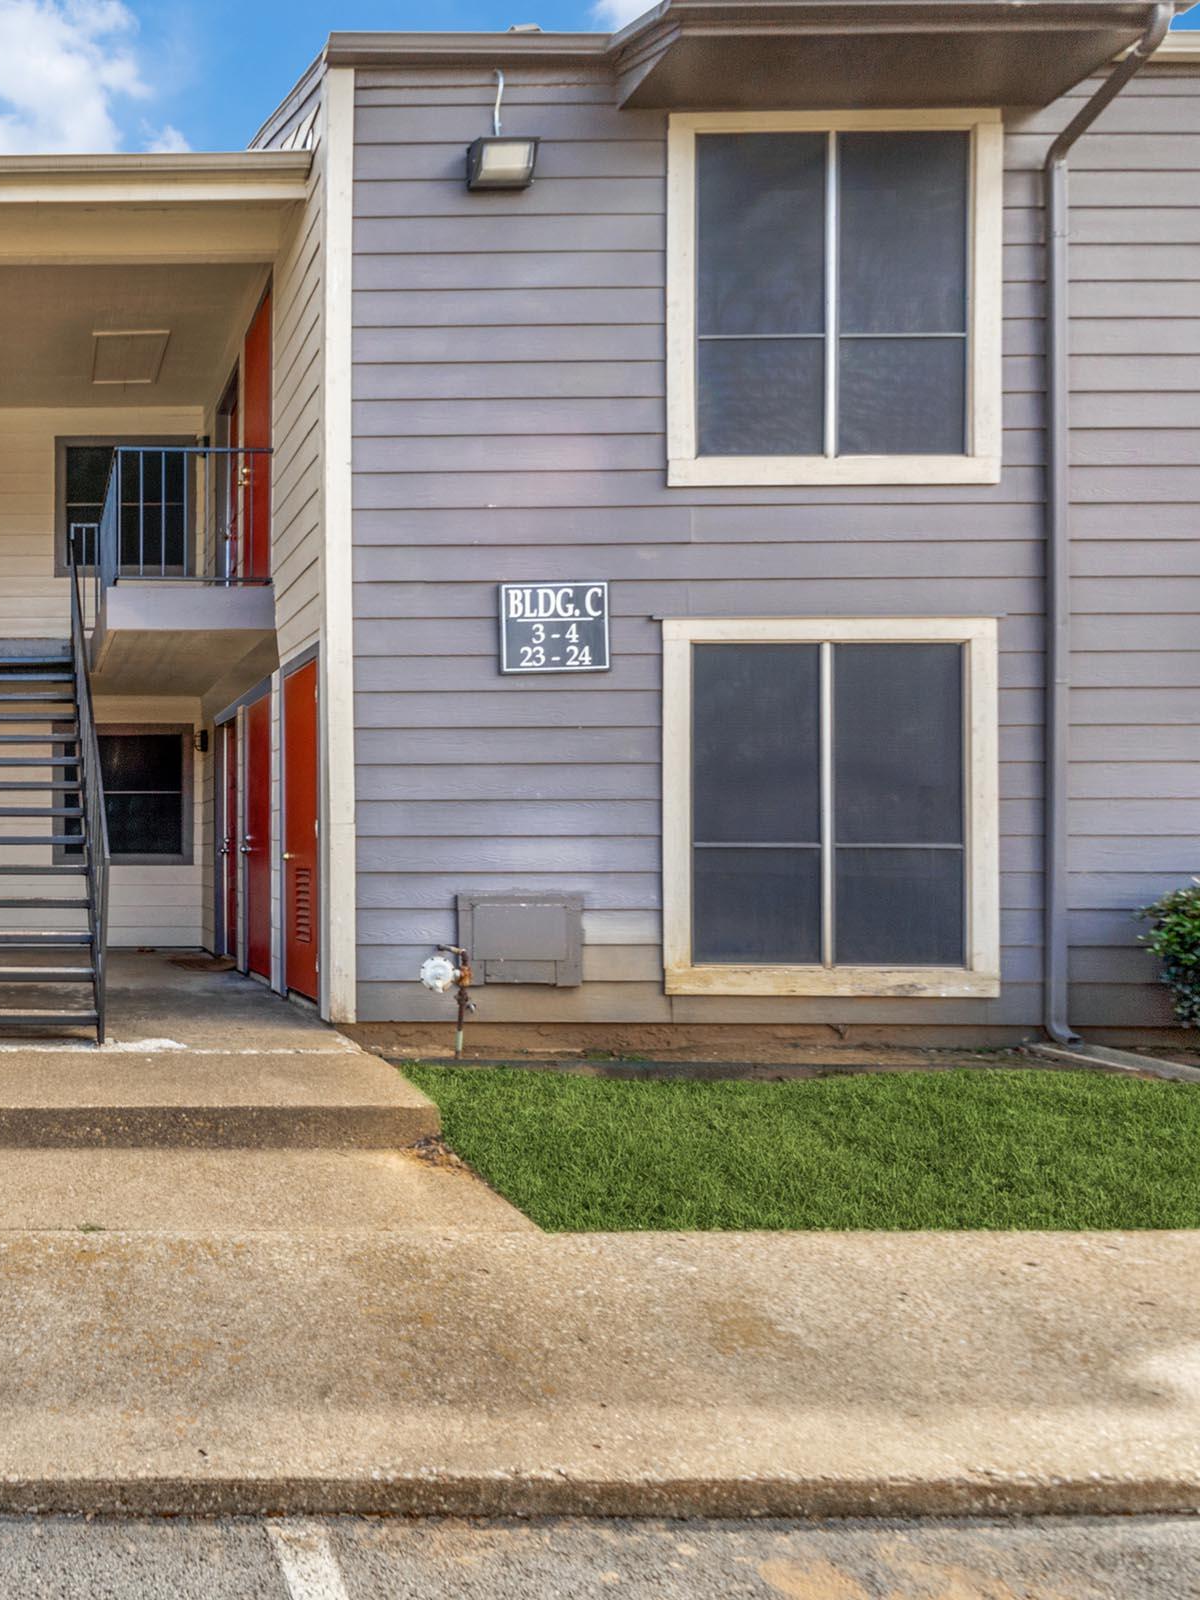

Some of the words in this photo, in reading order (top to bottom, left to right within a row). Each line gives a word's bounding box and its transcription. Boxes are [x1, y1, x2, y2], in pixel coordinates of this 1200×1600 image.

[508, 588, 581, 618] BLDG.
[585, 587, 602, 617] C
[532, 623, 546, 644] 3
[565, 623, 579, 643] 4
[520, 646, 546, 667] 23
[566, 645, 592, 666] 24
